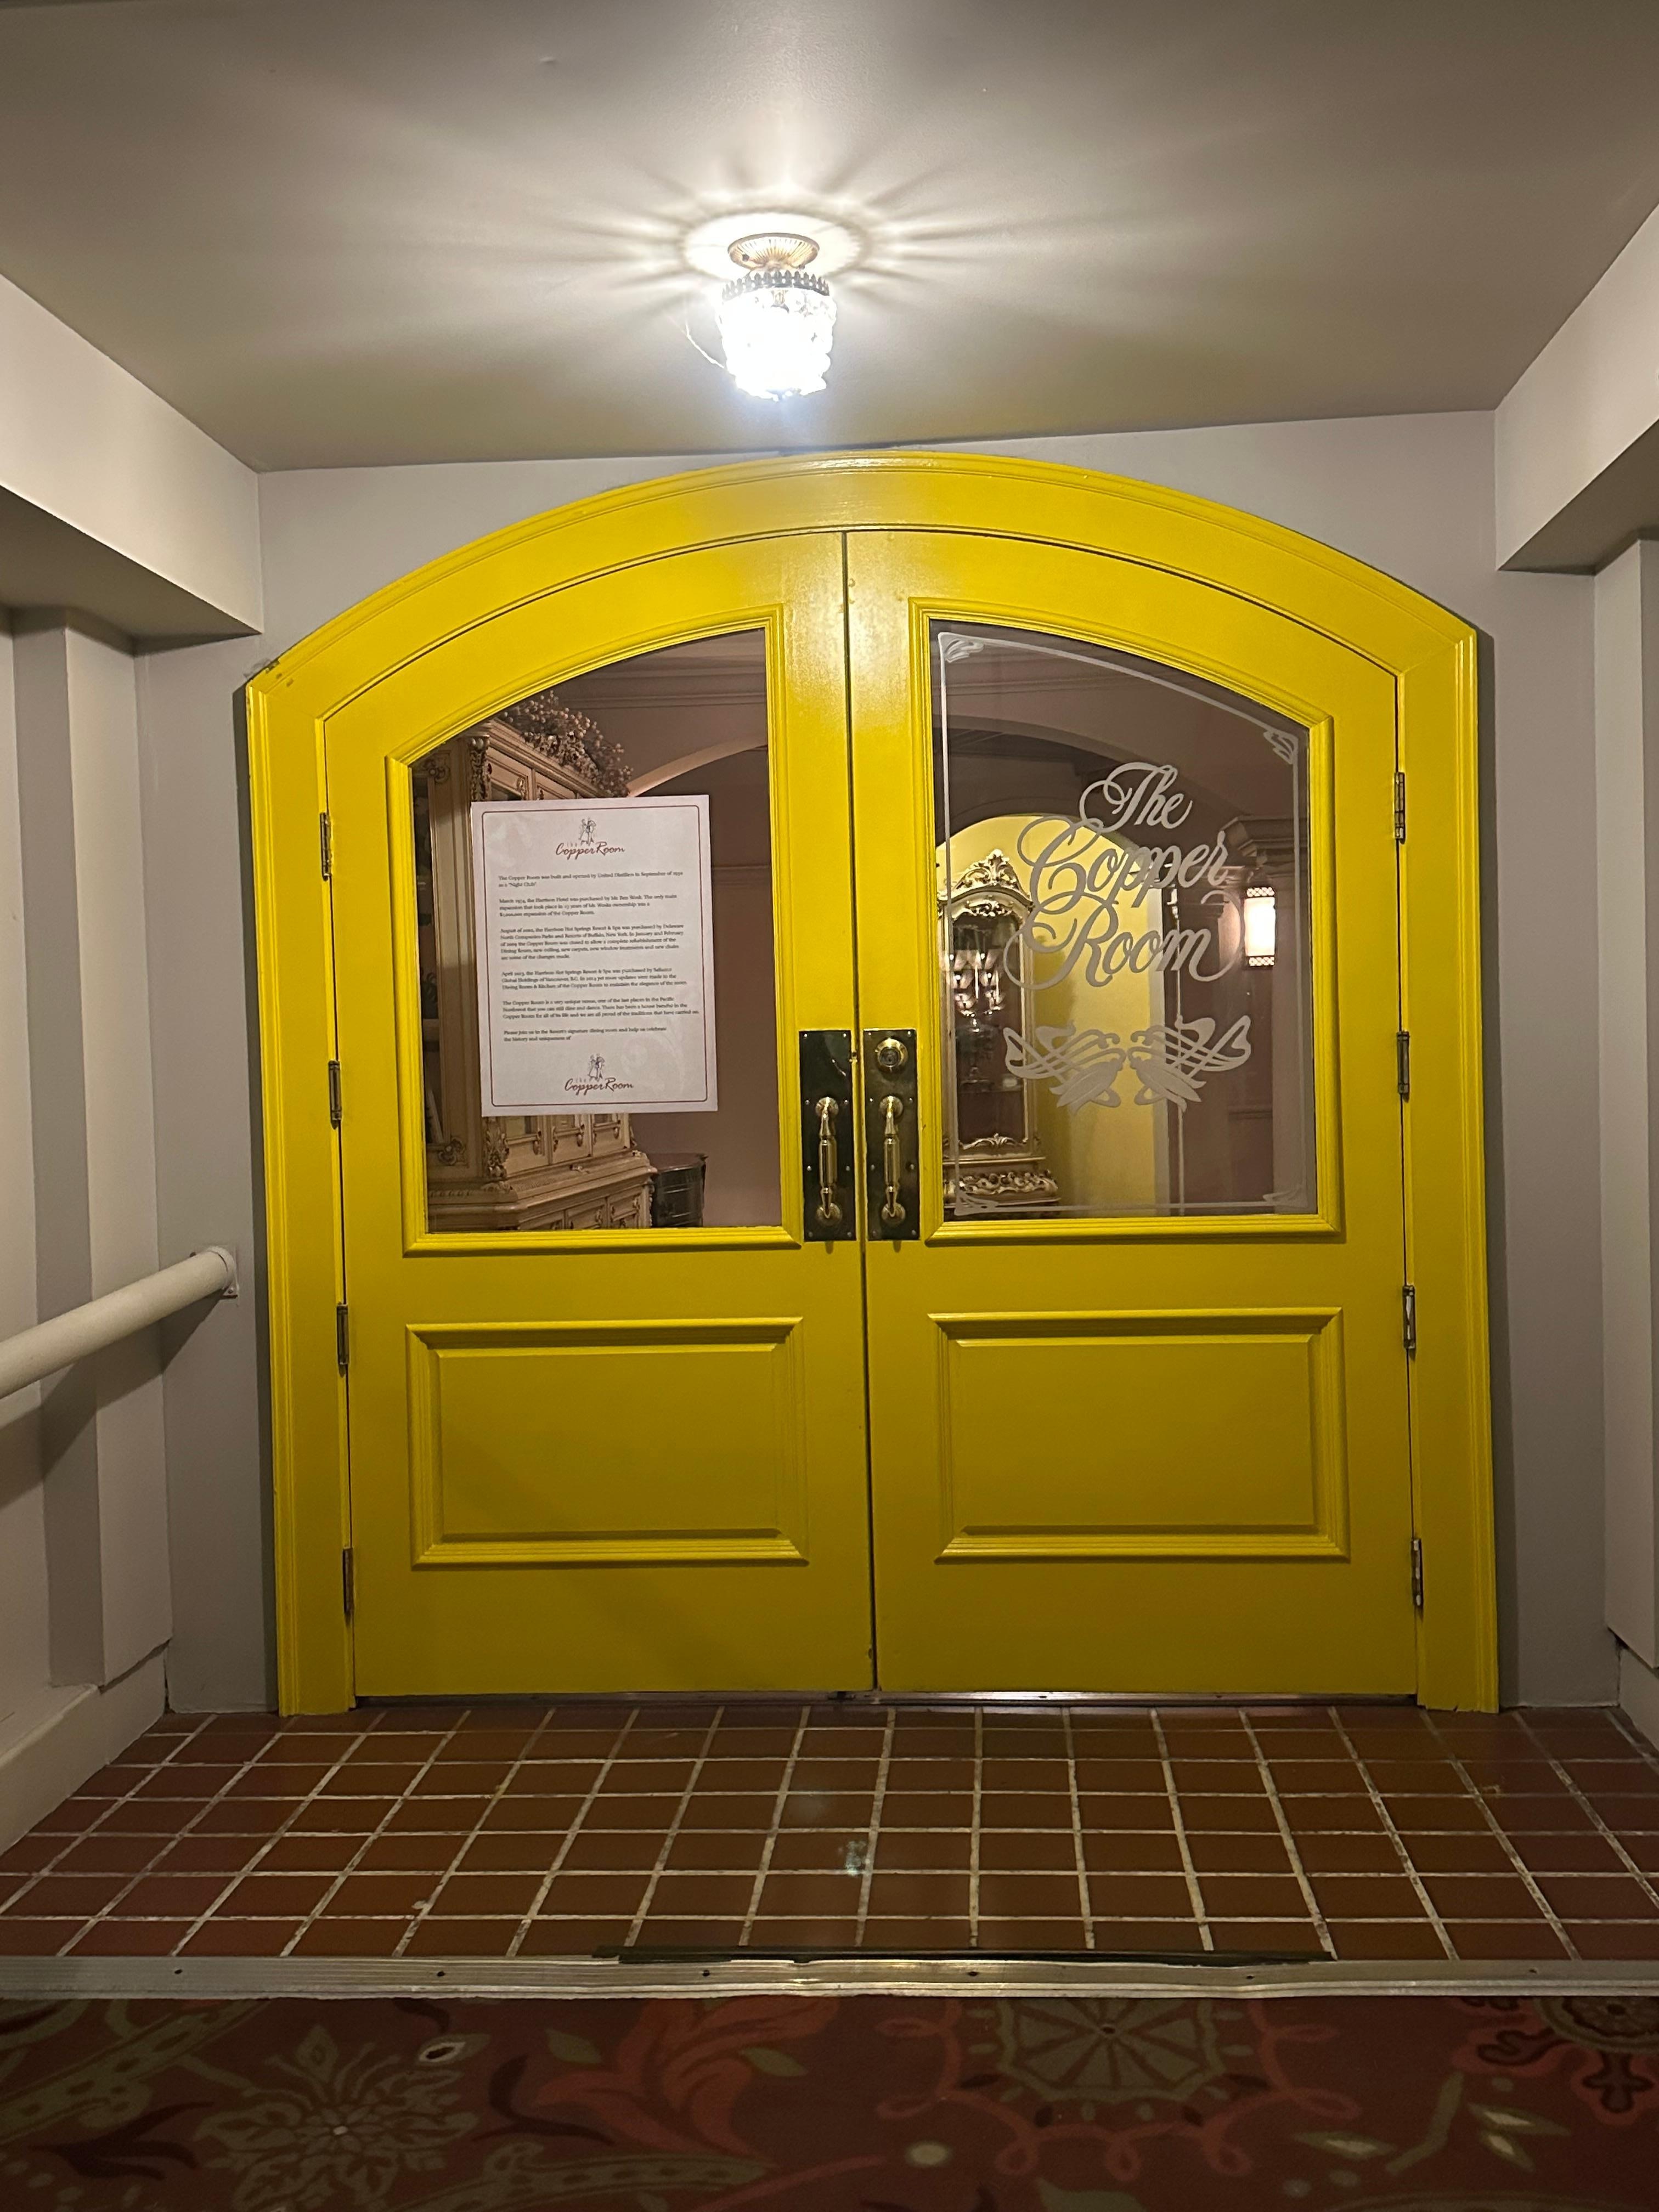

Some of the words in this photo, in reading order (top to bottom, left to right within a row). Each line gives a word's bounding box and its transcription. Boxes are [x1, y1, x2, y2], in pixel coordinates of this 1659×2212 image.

[1080, 762, 1193, 833] The
[1017, 815, 1229, 915] Copper
[1003, 890, 1245, 990] Room
